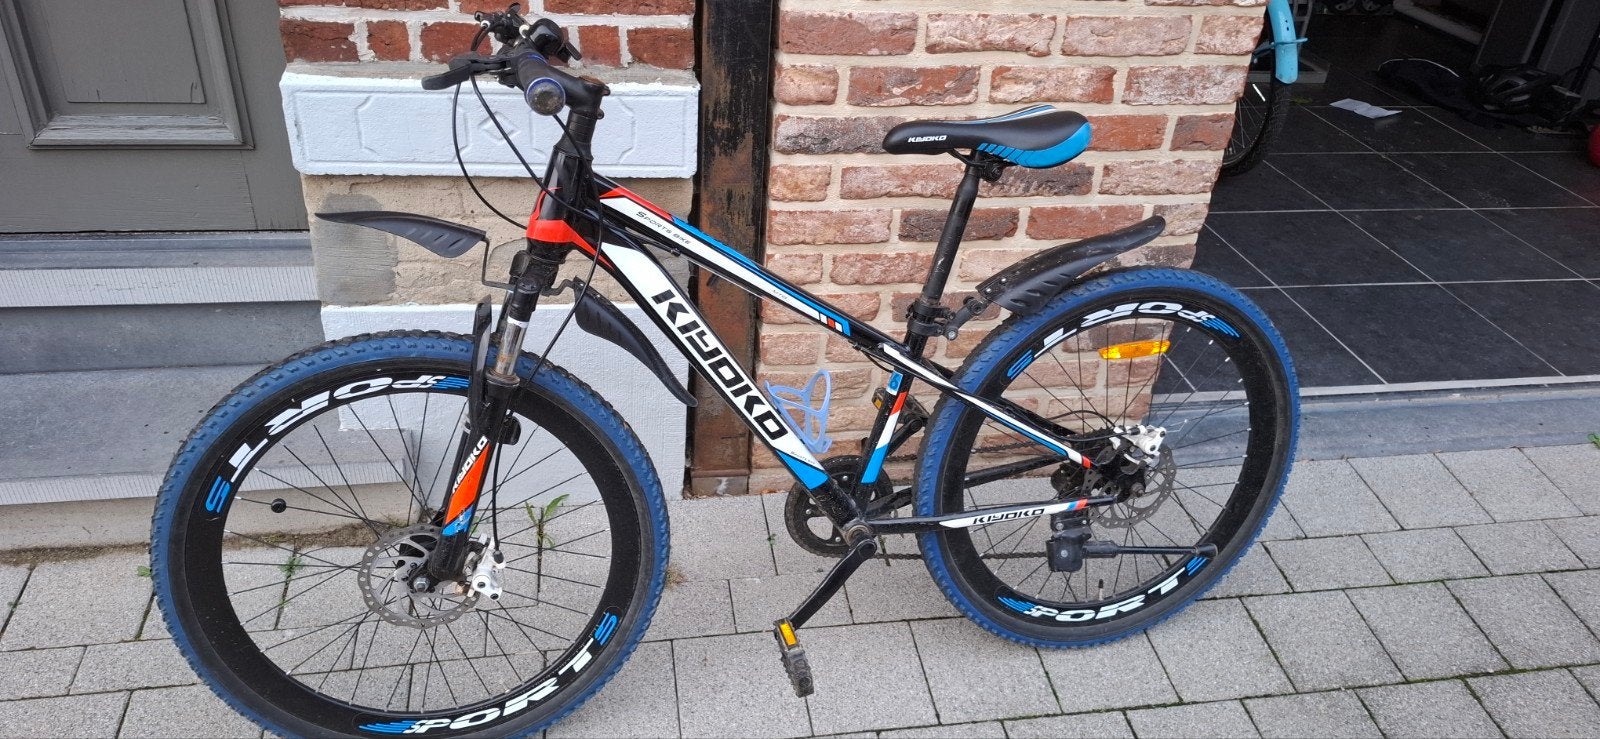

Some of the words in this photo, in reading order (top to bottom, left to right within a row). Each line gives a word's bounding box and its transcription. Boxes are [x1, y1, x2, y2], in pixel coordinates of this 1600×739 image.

[908, 135, 948, 143] KIYOKO
[651, 289, 789, 441] KIYOKO
[1007, 301, 1217, 380] SPORTS
[205, 375, 446, 513] SPORTS
[972, 507, 1045, 525] KIYOKO
[402, 611, 619, 734] SPORTS
